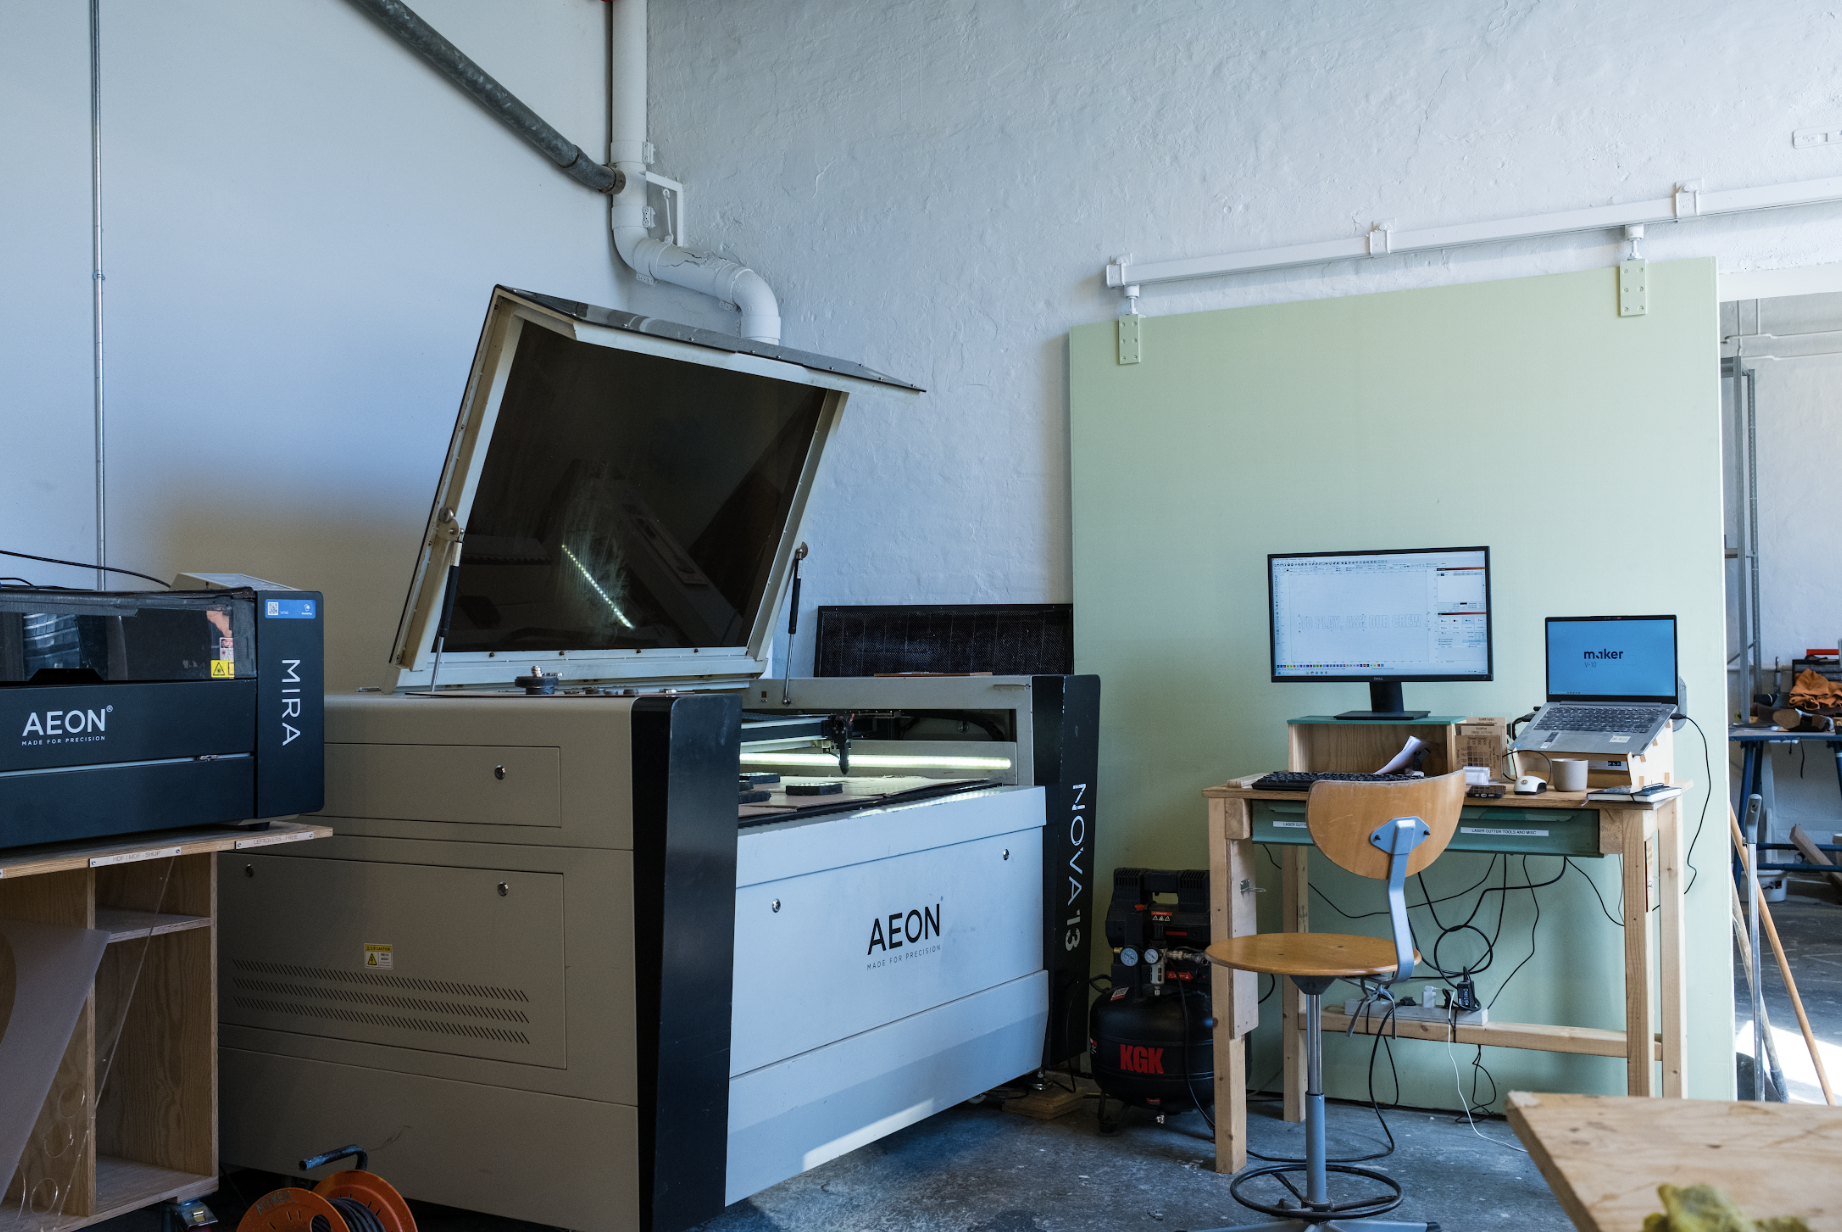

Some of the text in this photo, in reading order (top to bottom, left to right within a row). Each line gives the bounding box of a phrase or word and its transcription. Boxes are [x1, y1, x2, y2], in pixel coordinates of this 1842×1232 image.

[1346, 615, 1366, 629] ASK
[1369, 614, 1389, 629] OUR
[1392, 613, 1422, 628] CREW
[1584, 648, 1623, 659] maker
[281, 659, 301, 746] MIRA
[21, 739, 43, 747] MADE
[65, 735, 106, 743] PRECISION
[867, 944, 940, 970] MADE FOR PRECISION
[1120, 1043, 1164, 1074] KGK
